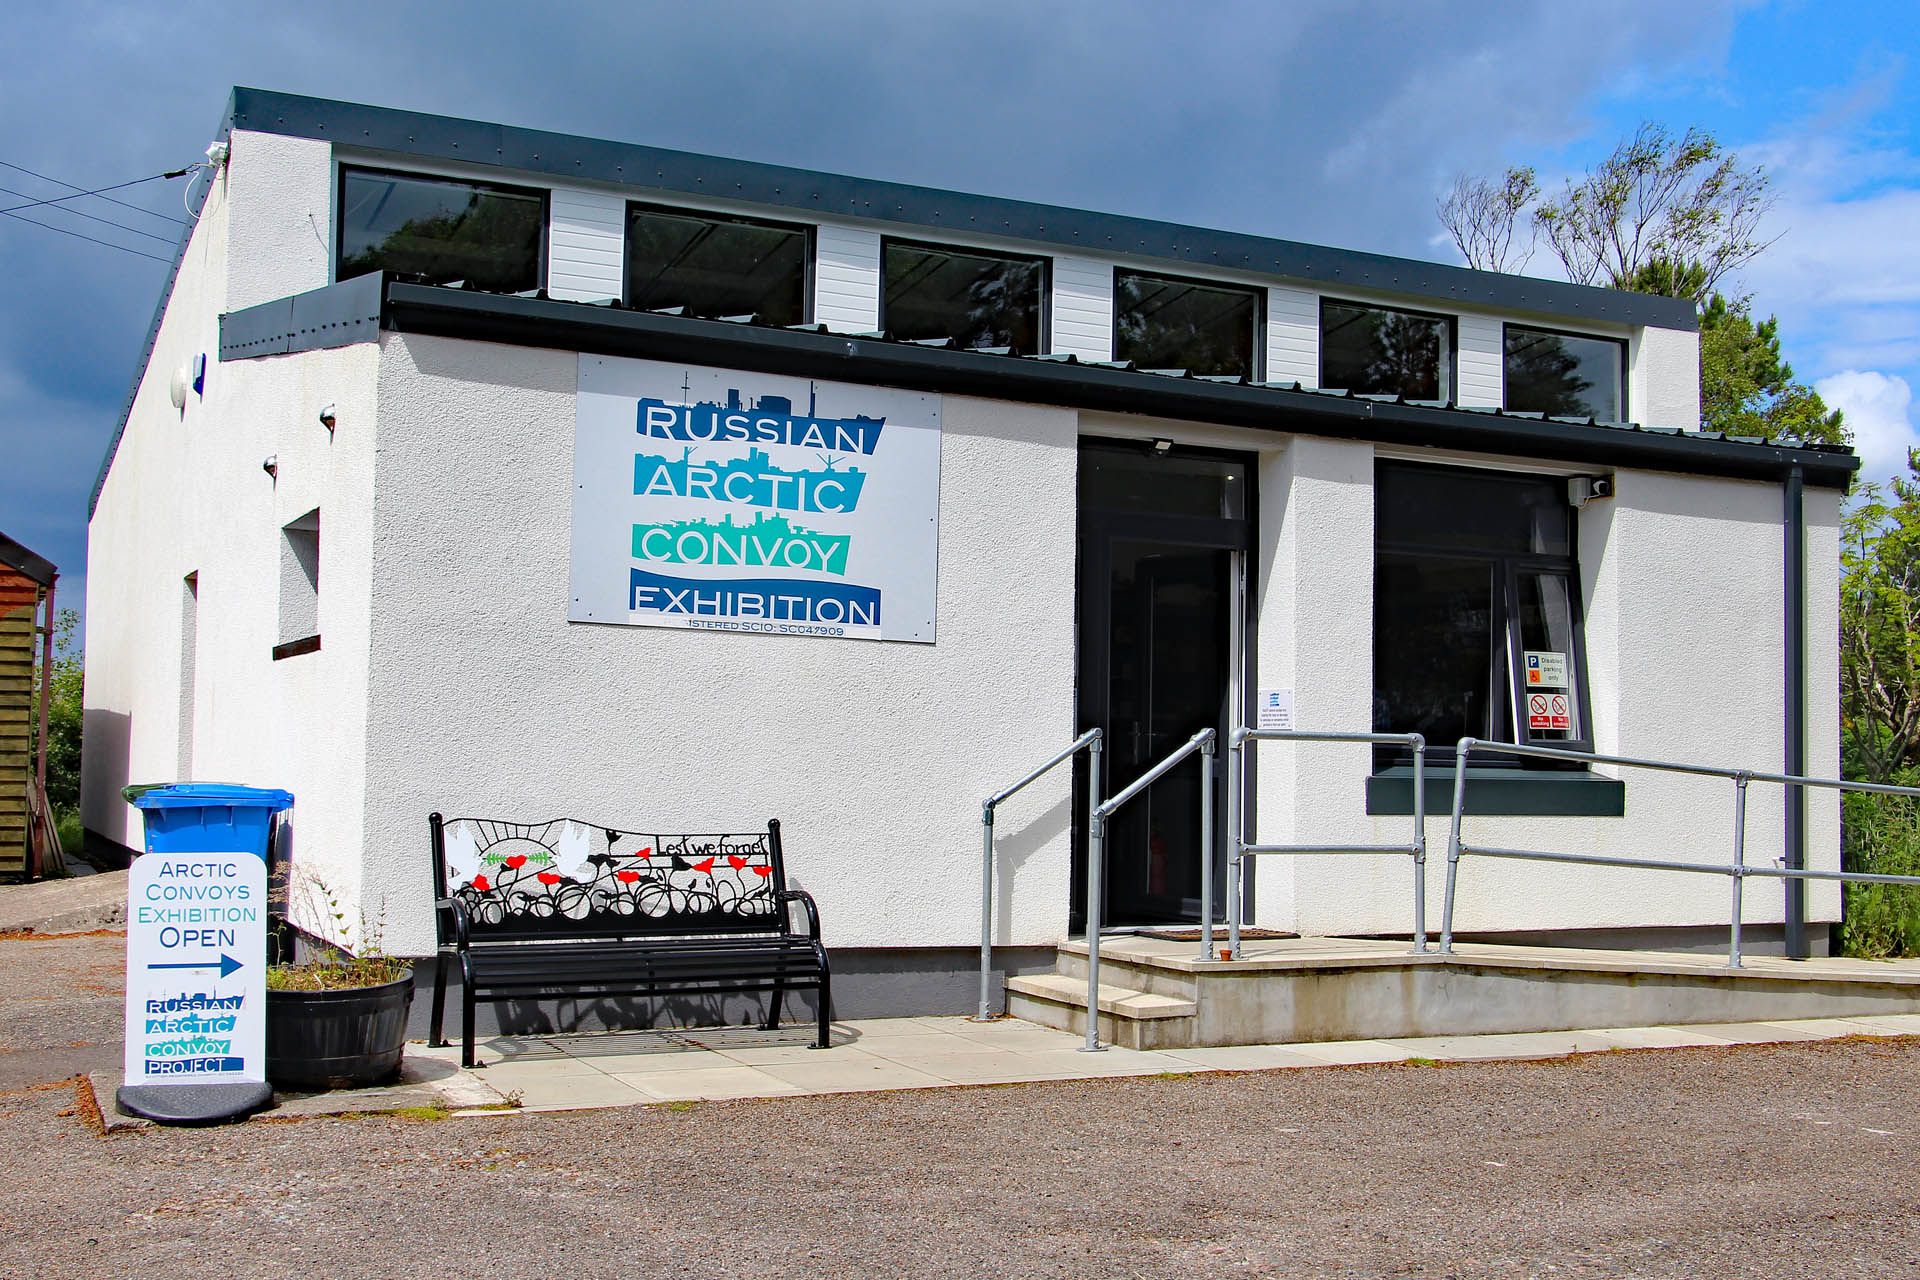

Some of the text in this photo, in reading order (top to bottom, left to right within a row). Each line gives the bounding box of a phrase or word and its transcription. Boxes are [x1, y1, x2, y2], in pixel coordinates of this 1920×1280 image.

[646, 406, 864, 455] RUSSIAN
[643, 464, 846, 513] ARCTIC
[641, 528, 841, 573] CONVOY
[634, 585, 875, 626] EXHIBITION
[684, 618, 845, 637] ISTERED SCIO: SC047909
[655, 835, 690, 856] Lest
[717, 834, 768, 860] forget
[159, 861, 237, 878] ARCTIC
[145, 884, 250, 901] CONVOYS
[138, 907, 256, 924] EXHIBITION
[159, 927, 235, 948] OPEN
[148, 1000, 237, 1014] RUSSIAN
[149, 1020, 230, 1034] ARCTIC
[148, 1041, 228, 1057] CONVOY
[148, 1058, 226, 1074] PROJECT
